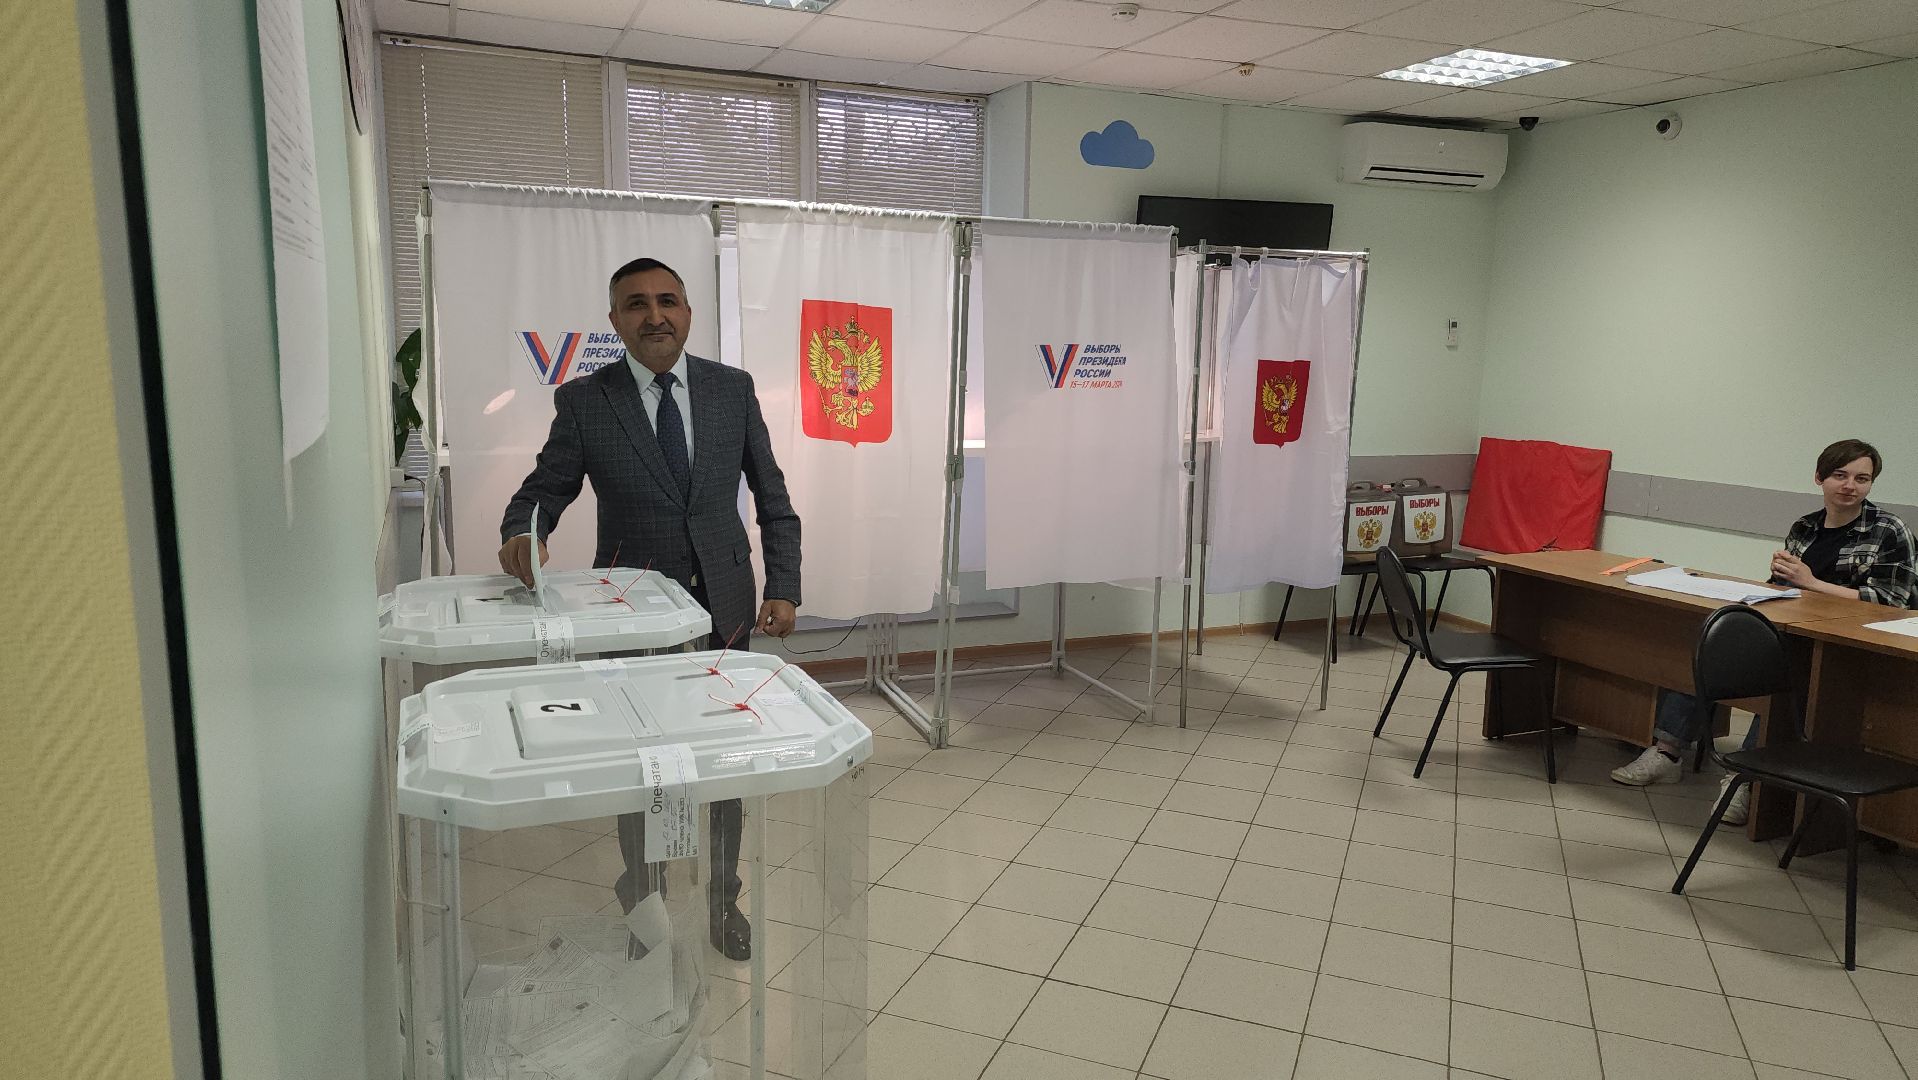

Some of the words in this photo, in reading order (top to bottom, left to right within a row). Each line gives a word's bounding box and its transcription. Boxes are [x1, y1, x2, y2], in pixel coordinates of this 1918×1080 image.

[1083, 344, 1122, 353] ВЫБОРЫ
[1073, 368, 1112, 378] РОССИИ
[1090, 380, 1111, 388] МАРТА
[1409, 498, 1440, 509] ВЫБОРЫ
[1355, 505, 1389, 517] ВЫБОРЫ
[540, 702, 582, 712] 2
